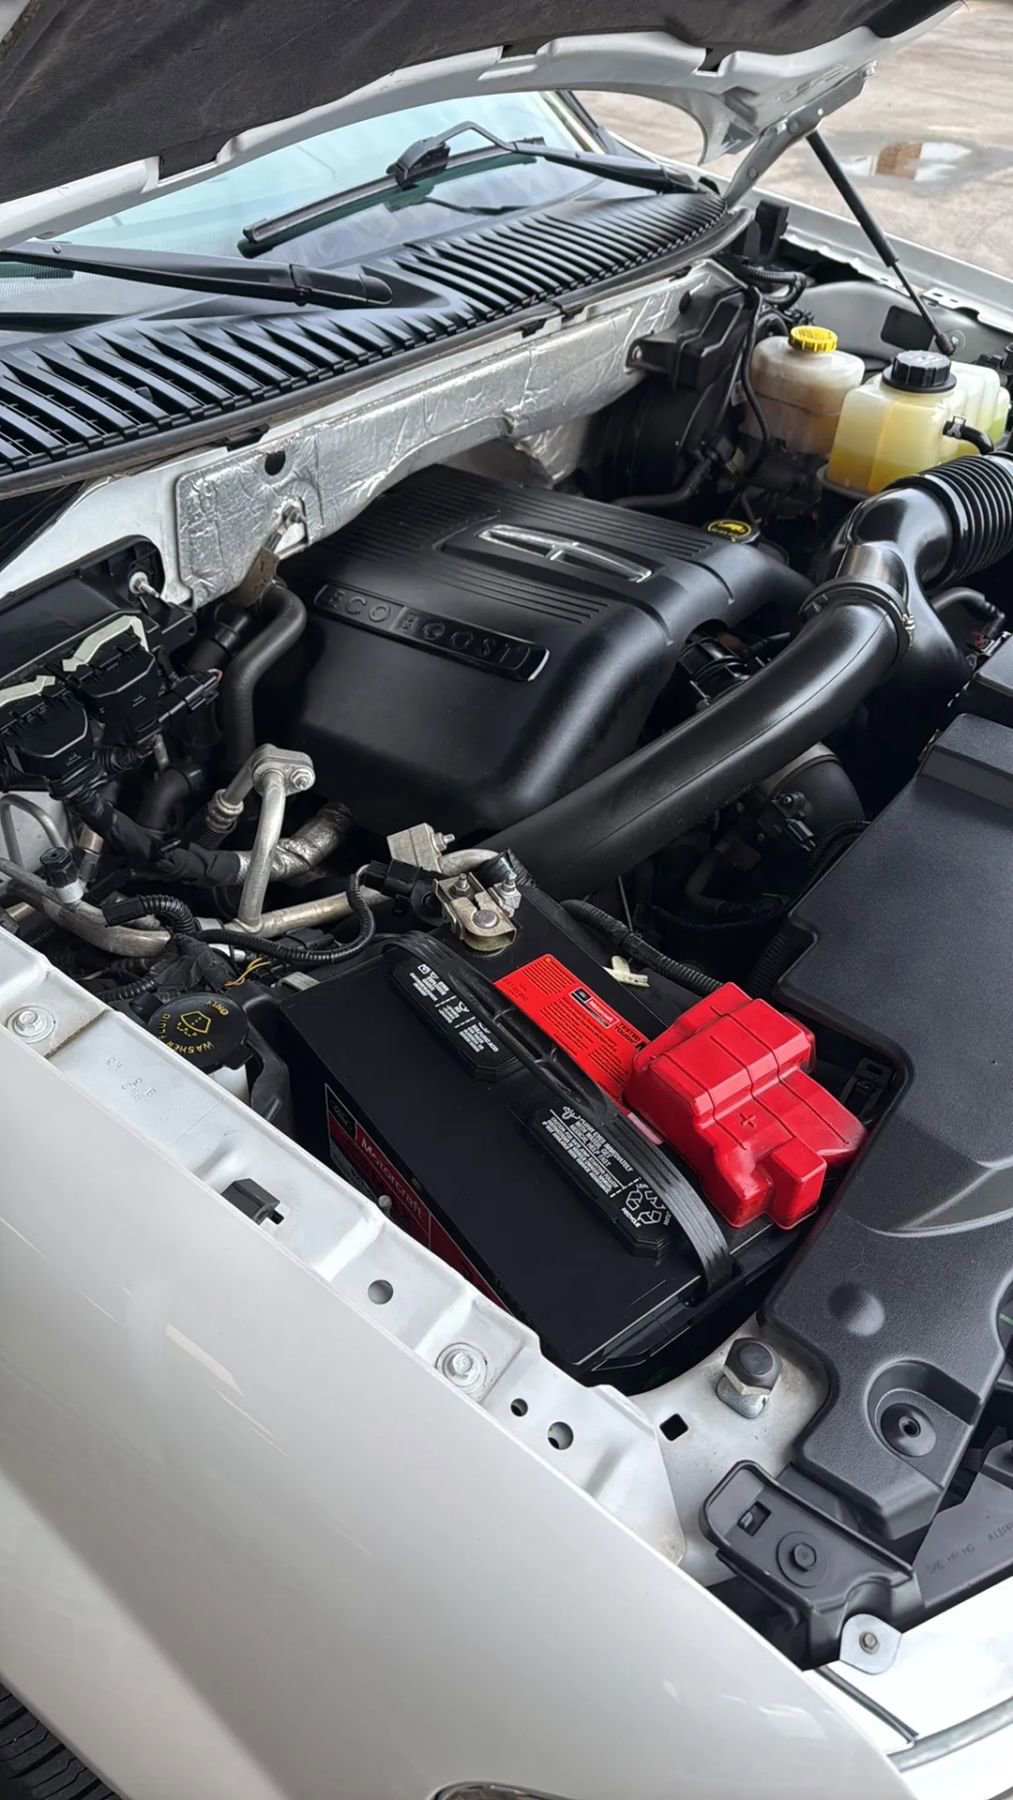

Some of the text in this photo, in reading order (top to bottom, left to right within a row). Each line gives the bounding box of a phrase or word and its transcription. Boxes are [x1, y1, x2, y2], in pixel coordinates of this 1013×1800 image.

[157, 1012, 214, 1054] WASHER FLUID
[362, 1139, 423, 1216] Motorcraft
